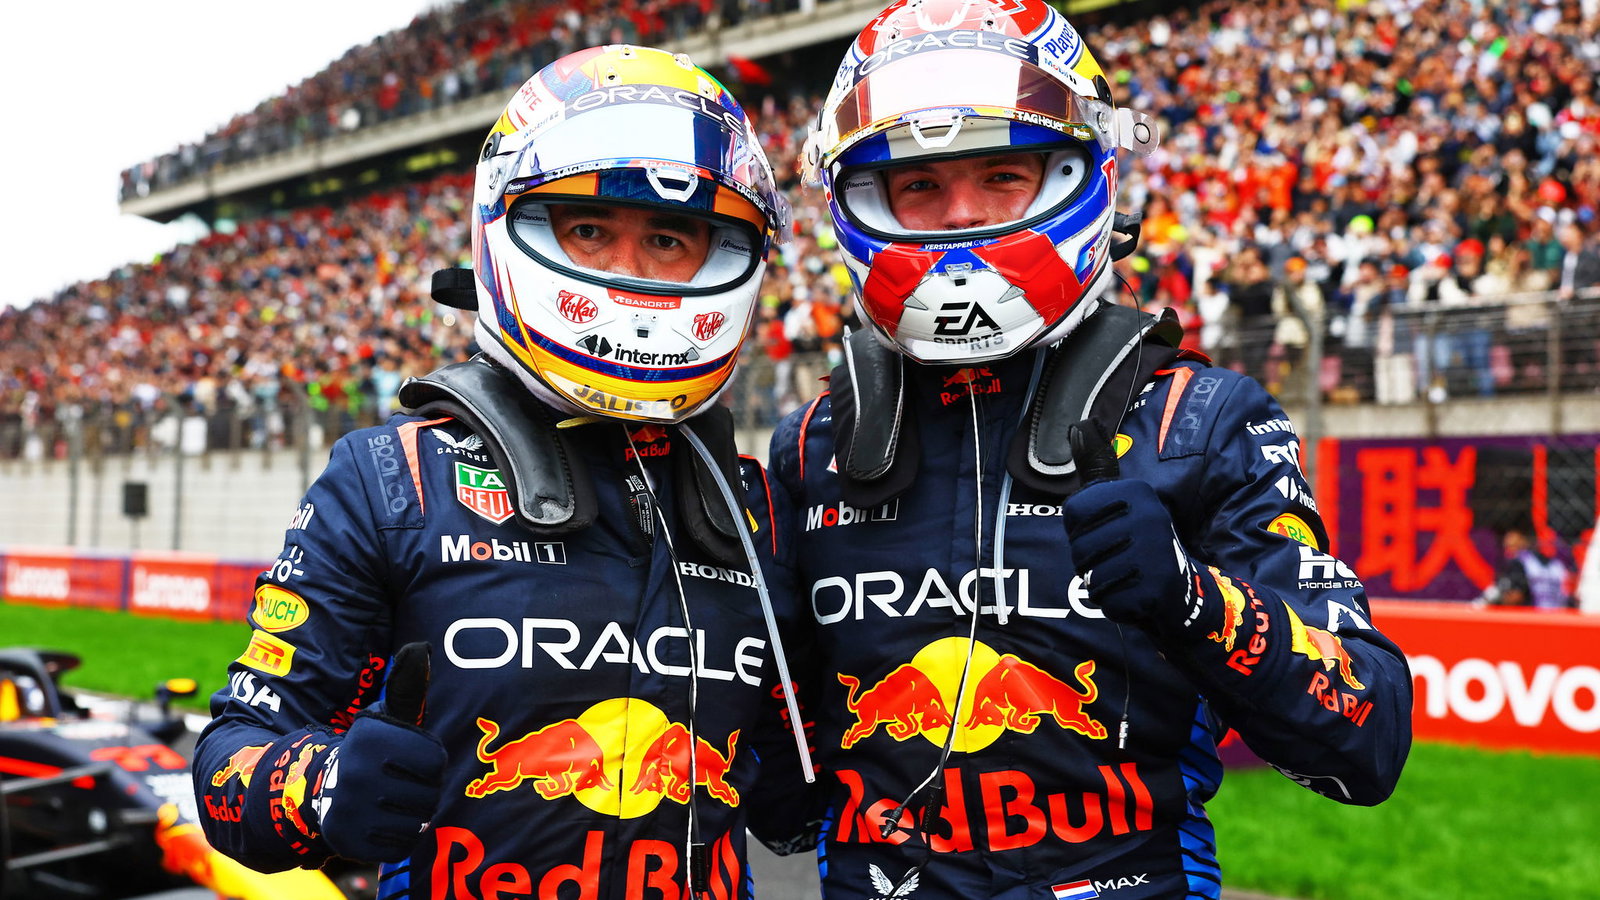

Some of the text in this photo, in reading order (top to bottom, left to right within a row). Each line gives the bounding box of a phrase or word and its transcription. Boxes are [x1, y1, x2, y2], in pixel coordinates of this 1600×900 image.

[859, 31, 1030, 77] ORACLE
[571, 86, 746, 137] ORACLE
[924, 239, 991, 250] VERSTAPPEN.COM
[625, 298, 676, 308] BANORTE
[933, 301, 1002, 335] EA
[614, 343, 691, 366] inter.mx
[933, 331, 1004, 351] SPORTS
[573, 384, 688, 414] JALISCO
[437, 447, 488, 462] CASTORE
[649, 441, 671, 458] Bull
[368, 434, 408, 515] sparco
[461, 467, 506, 488] TA
[440, 534, 532, 563] Mobil
[811, 567, 1107, 626] ORACLE
[1297, 580, 1342, 590] Honda
[443, 617, 767, 687] ORACLE
[1408, 655, 1600, 734] novo
[834, 761, 1154, 854] Red Bull
[430, 825, 605, 900] Red
[1094, 872, 1151, 893] MAX
